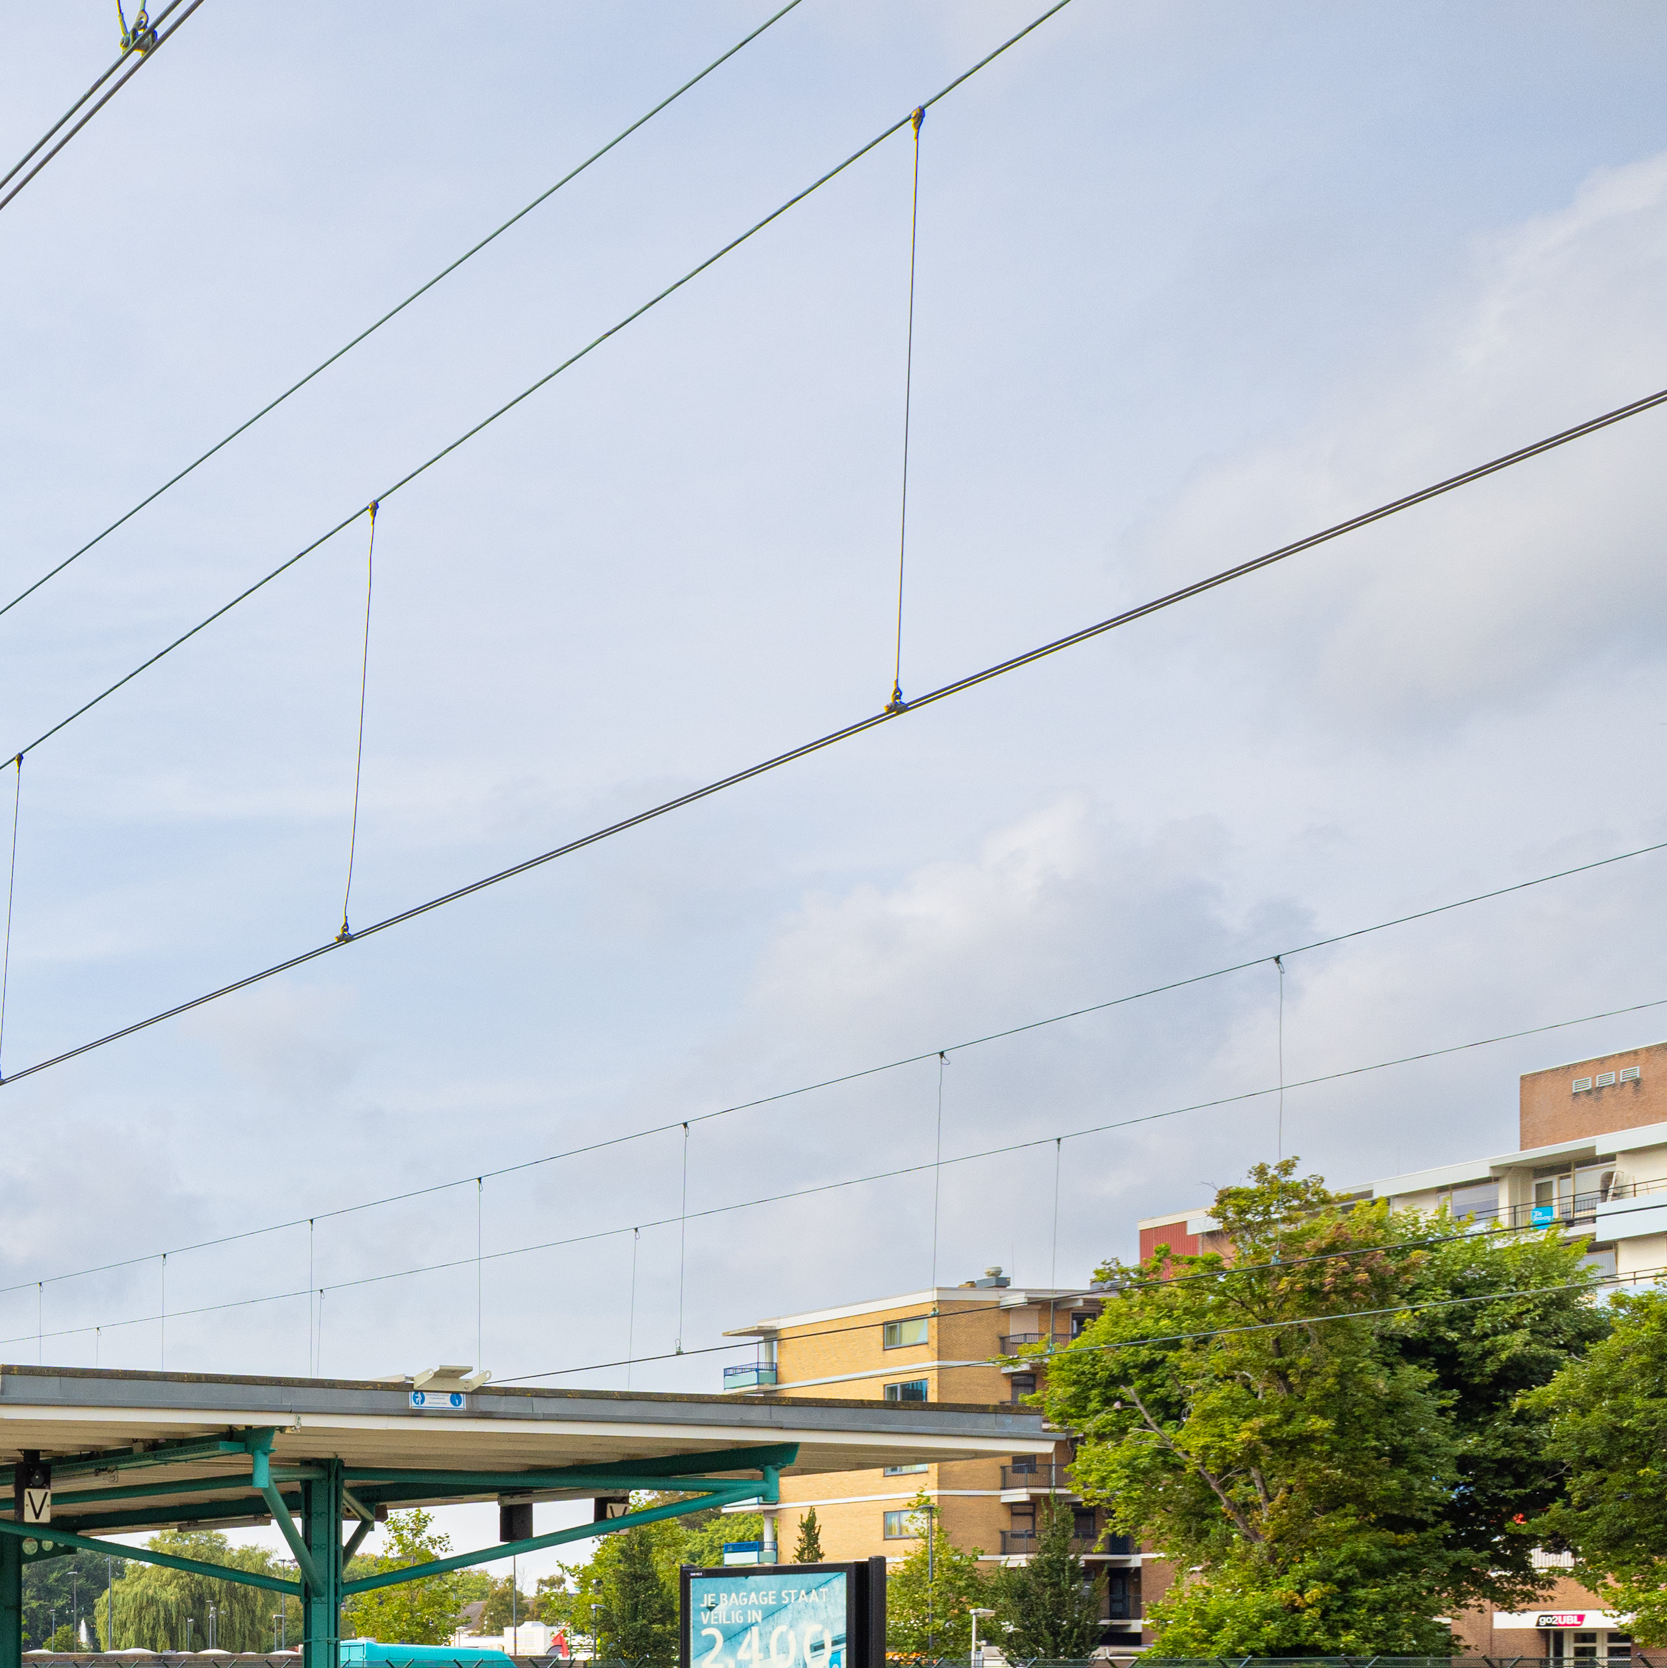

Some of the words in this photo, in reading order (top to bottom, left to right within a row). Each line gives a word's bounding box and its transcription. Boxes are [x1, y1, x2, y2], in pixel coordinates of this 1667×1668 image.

[27, 1491, 49, 1520] V
[699, 1593, 717, 1608] JE
[719, 1590, 777, 1606] BAGAGE
[781, 1588, 829, 1604] STAAT
[700, 1609, 744, 1625] VEILIG
[747, 1609, 763, 1623] IN
[1538, 1615, 1582, 1626] go2UBL
